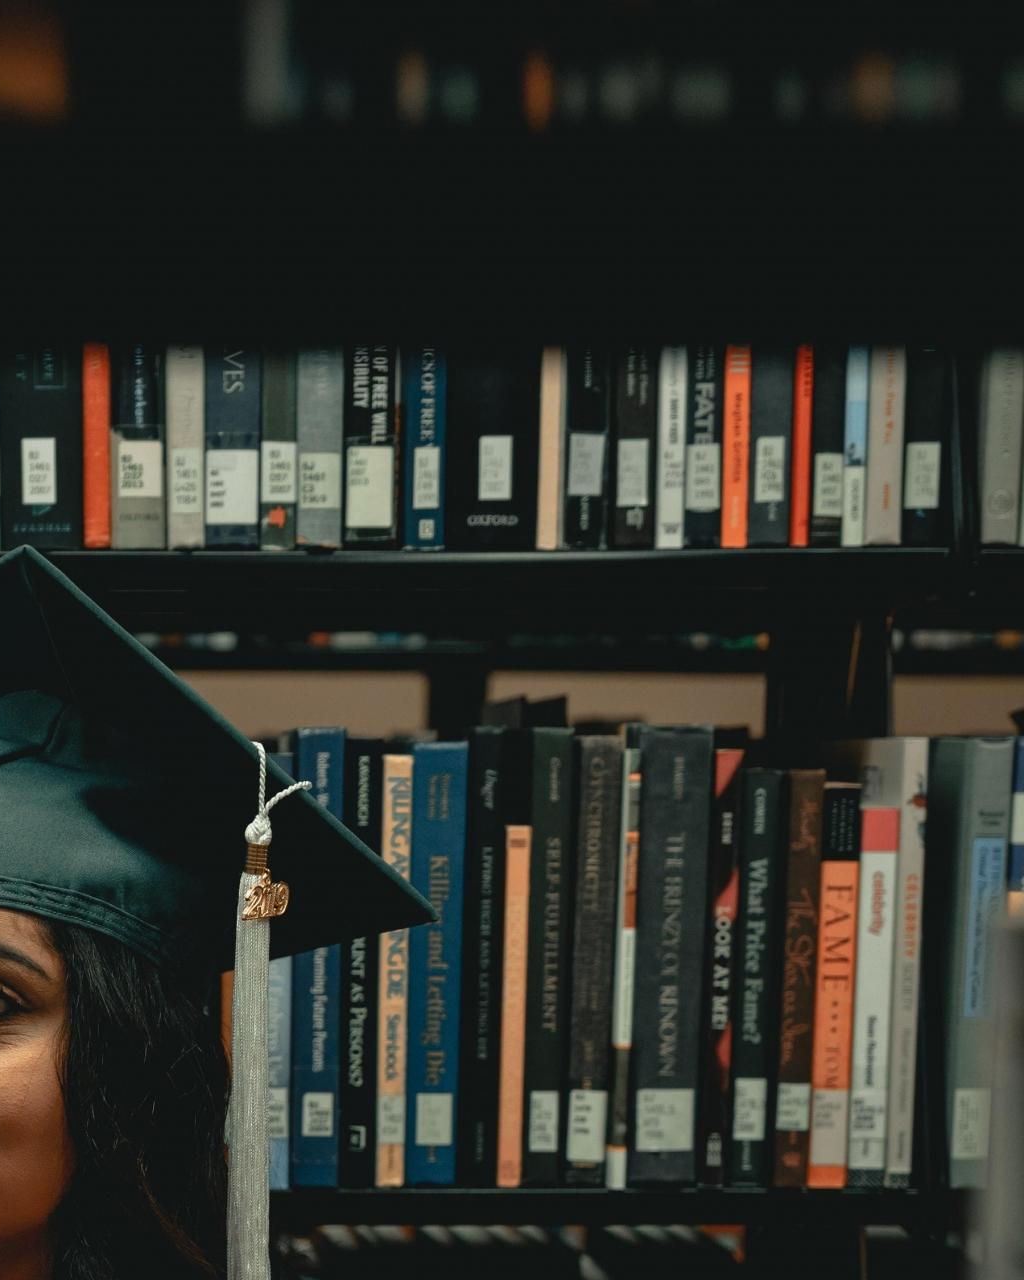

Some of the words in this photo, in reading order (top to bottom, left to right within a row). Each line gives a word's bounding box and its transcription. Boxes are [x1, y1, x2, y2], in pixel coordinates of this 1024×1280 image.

[372, 376, 389, 409] FREE
[420, 372, 435, 395] OF
[419, 398, 435, 441] FREE
[693, 382, 716, 445] FATE
[466, 514, 518, 527] OXFORD
[387, 776, 412, 848] KILLING
[752, 788, 767, 834] COWEN
[665, 831, 686, 869] THE
[746, 858, 769, 918] What
[869, 872, 886, 936] celebrity
[541, 837, 561, 1033] SELF-FULFILLMENT
[712, 906, 731, 958] LOOK
[822, 884, 856, 994] FAME
[903, 874, 919, 958] CELEBRITY
[349, 937, 365, 979] UNT
[428, 931, 447, 970] and
[744, 922, 765, 973] Price
[350, 983, 364, 1003] AS
[387, 969, 405, 1000] DIE
[712, 964, 730, 990] AT
[423, 974, 445, 1045] Letting
[656, 984, 680, 1078] RENOWN
[711, 995, 729, 1031] ME!
[741, 976, 764, 1045] Fame?
[347, 1007, 365, 1087] PERSONS?
[385, 1013, 402, 1083] Steinbock
[425, 1051, 444, 1085] Die
